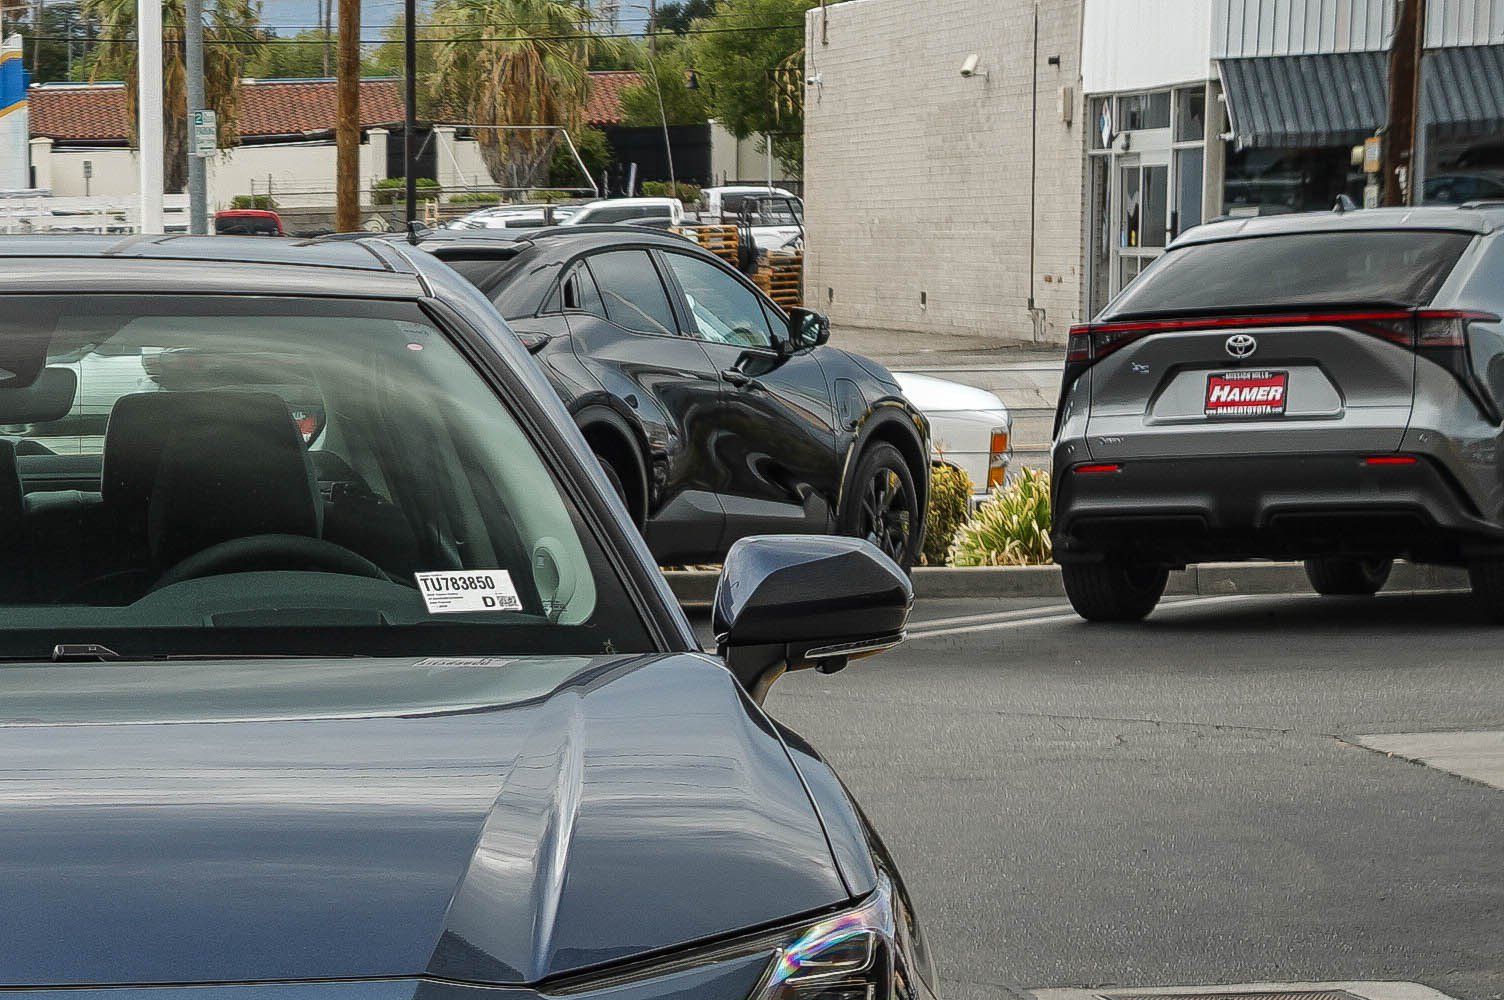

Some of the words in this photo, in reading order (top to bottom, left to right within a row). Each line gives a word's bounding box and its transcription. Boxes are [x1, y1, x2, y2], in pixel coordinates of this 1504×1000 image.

[1209, 384, 1284, 403] HAMER
[420, 575, 495, 592] TU783850
[482, 596, 496, 608] D
